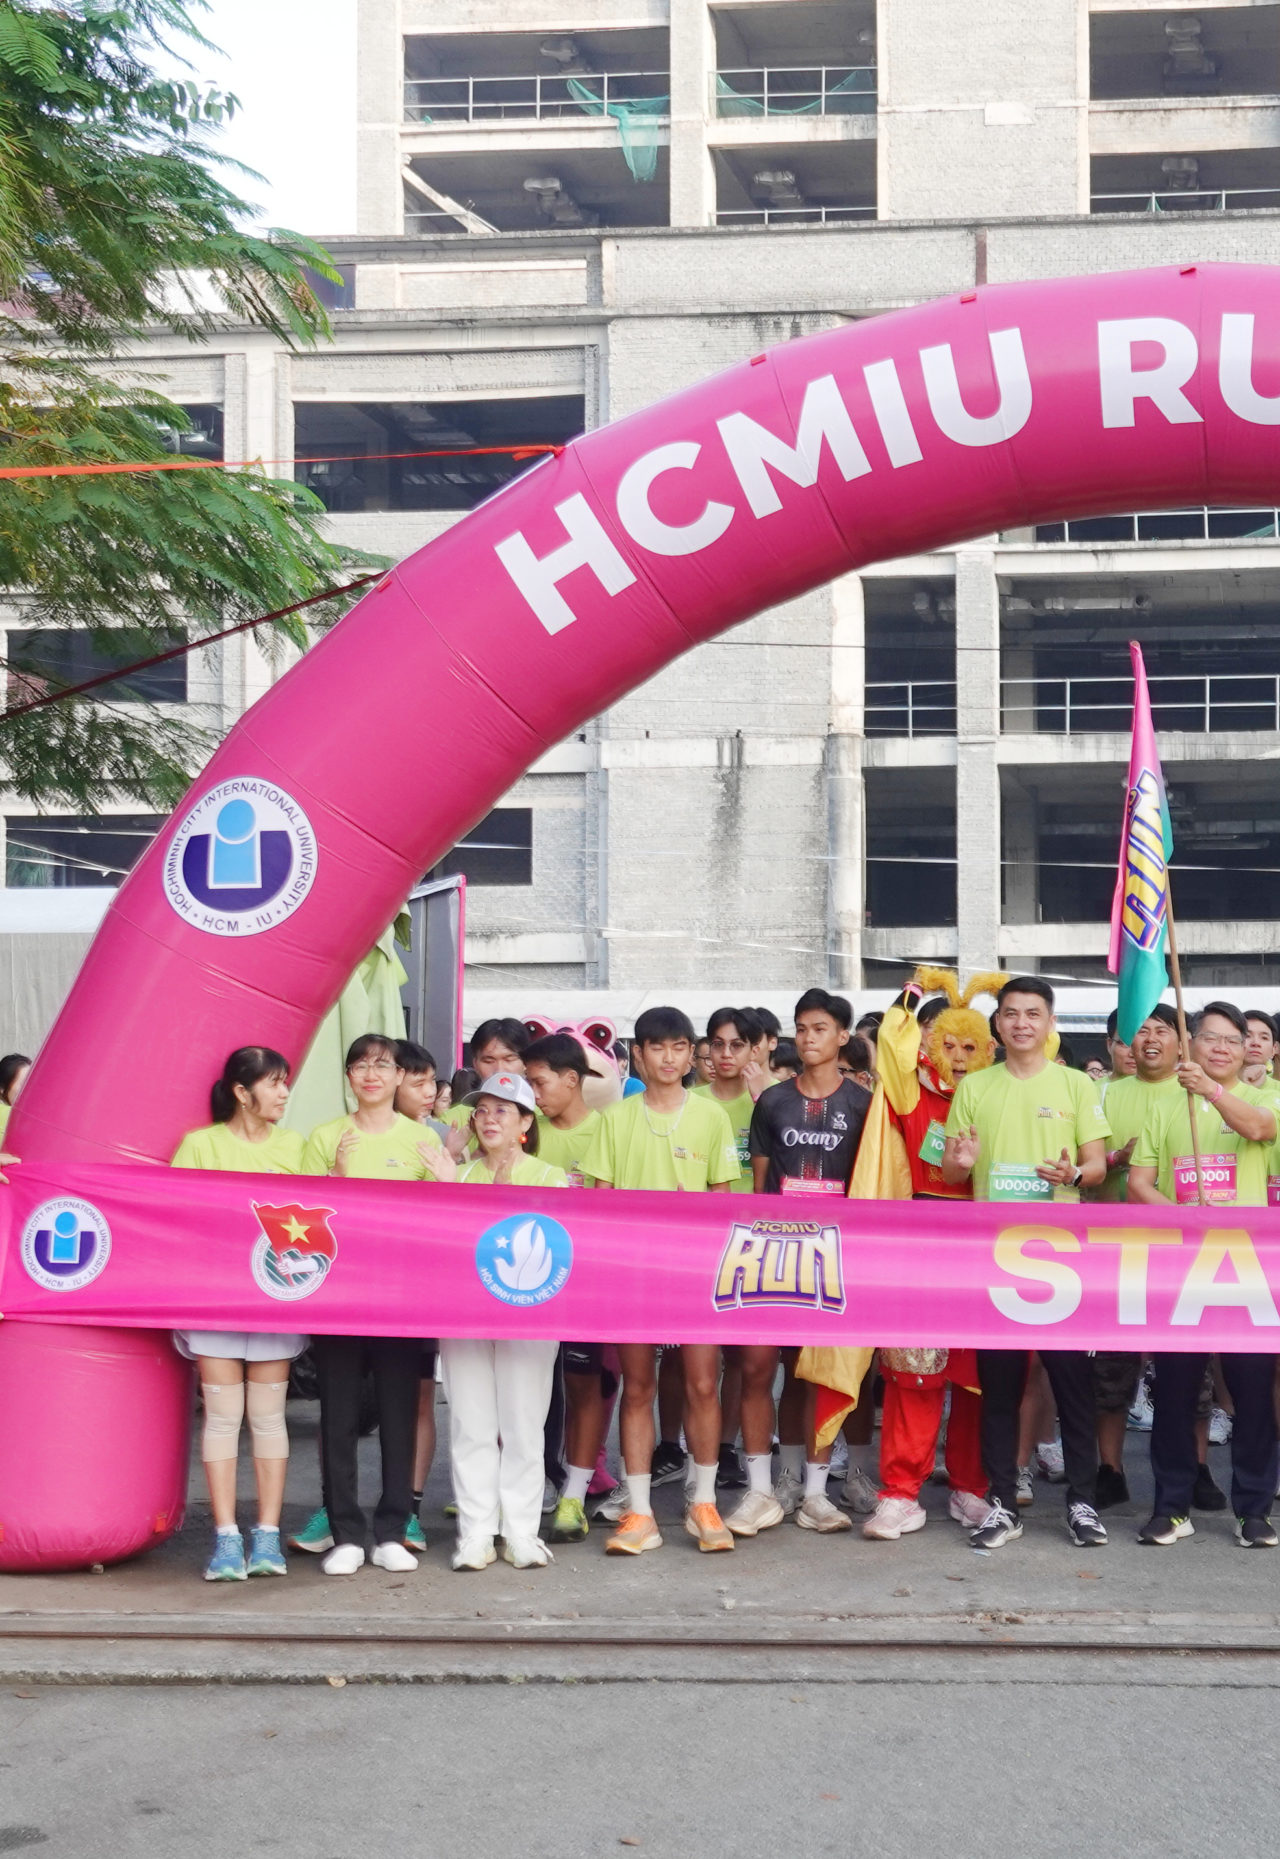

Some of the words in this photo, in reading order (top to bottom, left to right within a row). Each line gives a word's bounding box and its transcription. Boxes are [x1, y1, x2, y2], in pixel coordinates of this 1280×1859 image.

[494, 327, 1034, 636] HCMIU
[167, 838, 192, 914] HOCHIMINH
[181, 807, 203, 834] CITY
[205, 781, 300, 825] INTERNATIONAL
[281, 826, 313, 911] UNIVERSITY
[202, 914, 240, 932] HCM
[256, 912, 274, 928] IU
[783, 1128, 844, 1152] Ocany
[994, 1179, 1050, 1193] U00062
[752, 1222, 820, 1234] HCMIU
[714, 1224, 845, 1312] RUN
